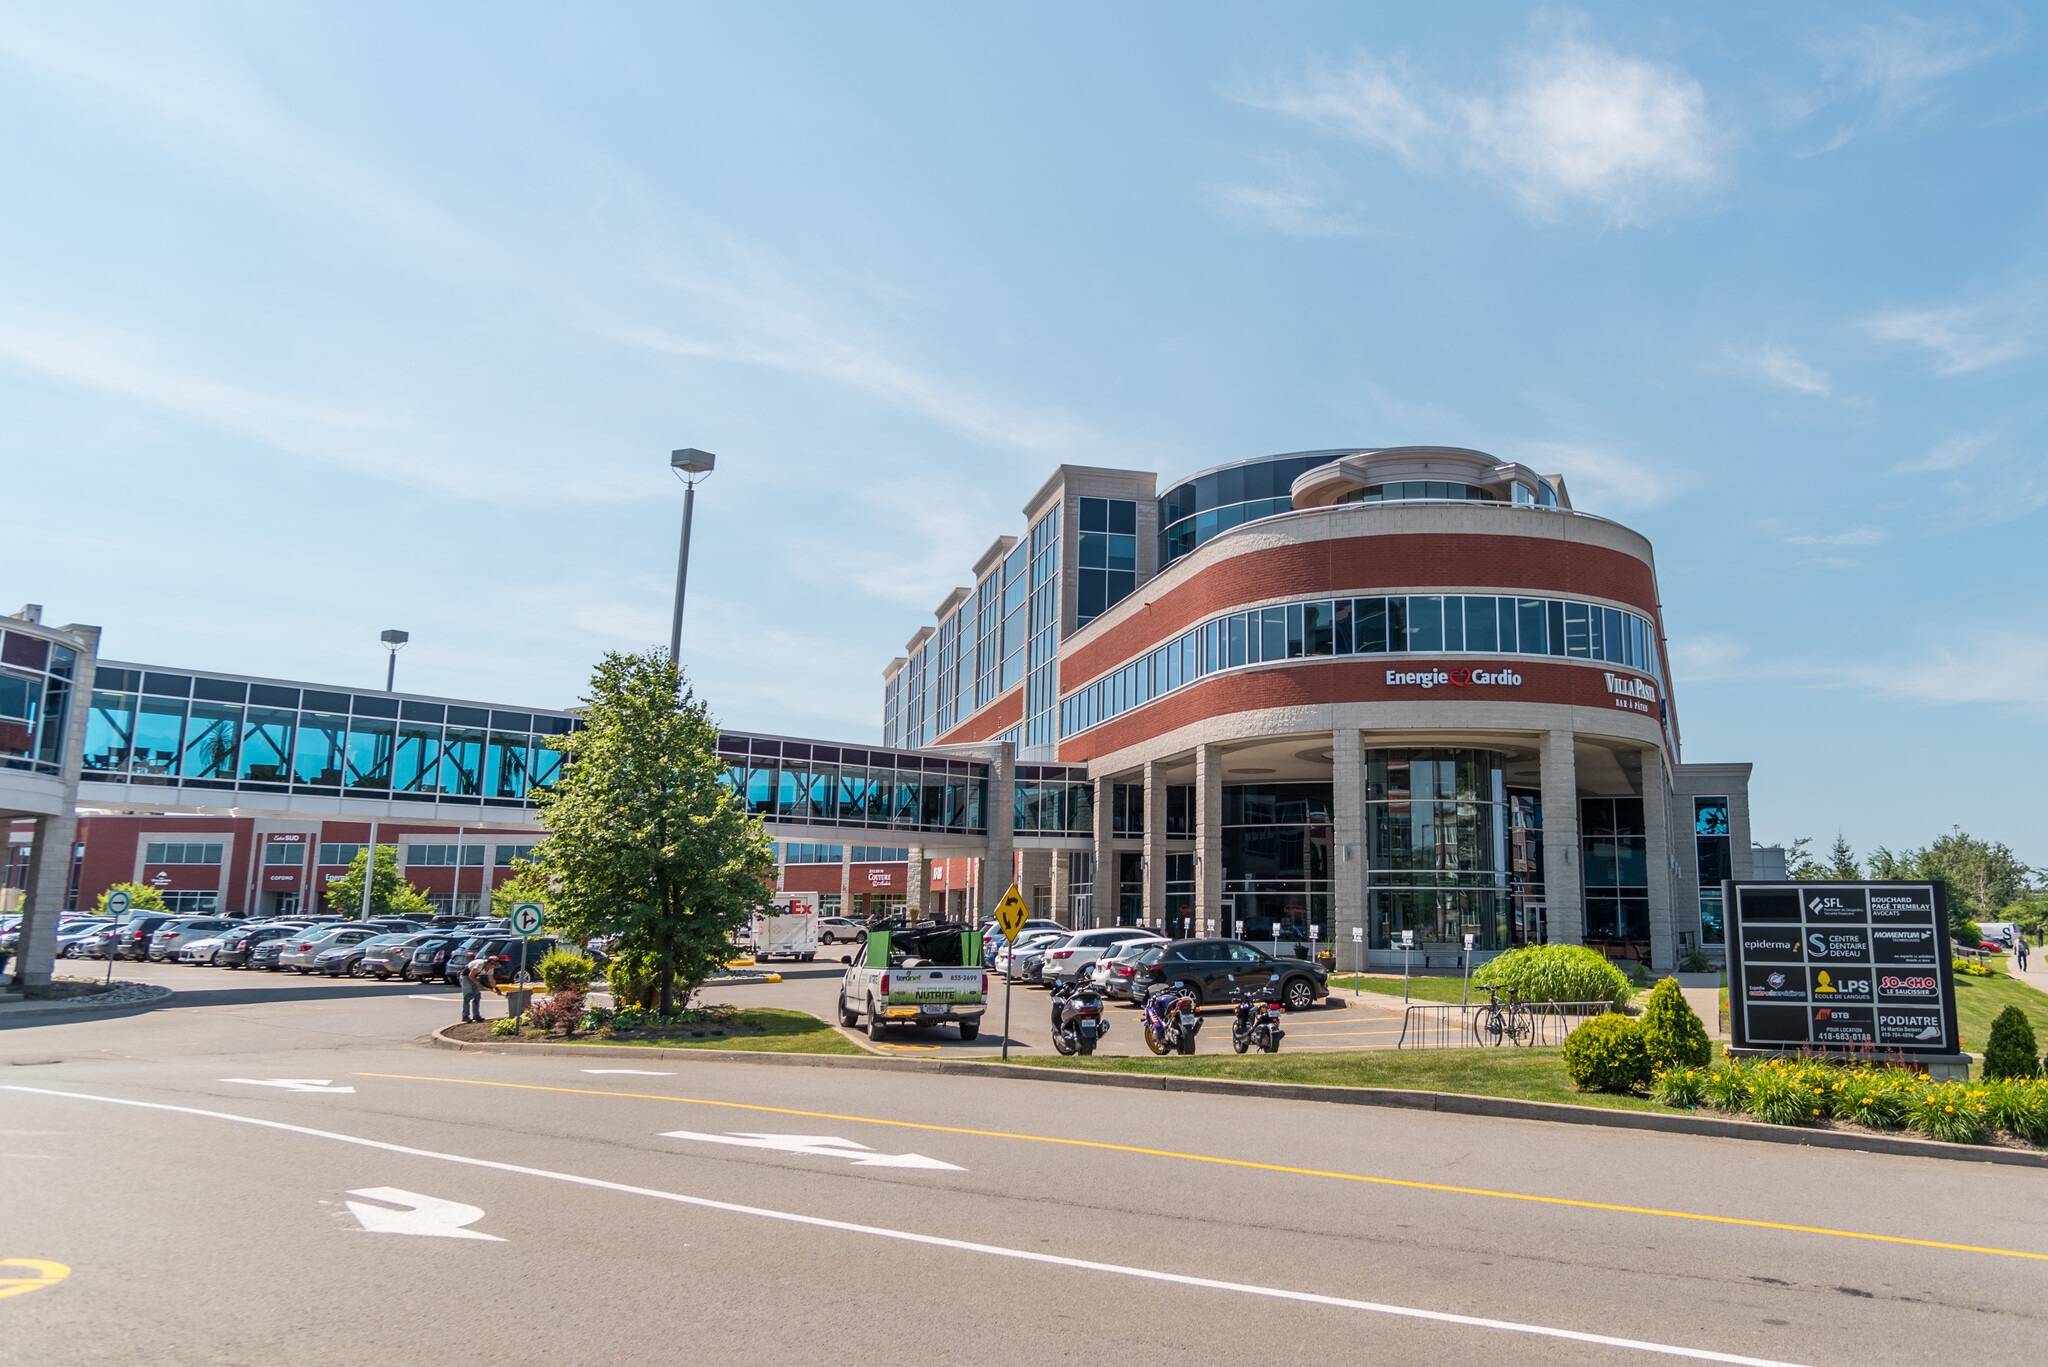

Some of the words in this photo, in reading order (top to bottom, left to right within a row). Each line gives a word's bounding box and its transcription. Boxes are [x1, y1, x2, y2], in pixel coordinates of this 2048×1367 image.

[1386, 668, 1448, 689] Energie
[1471, 668, 1522, 686] Cardio
[768, 899, 813, 915] edEx
[1823, 897, 1843, 908] SFL
[1744, 939, 1791, 950] epiderma
[1828, 935, 1859, 943] CENTRE
[1829, 942, 1867, 950] DENTAIRE
[1830, 949, 1861, 957] DEVEAU
[1838, 980, 1870, 993] LPS
[1881, 975, 1936, 989] SO-CHO
[915, 991, 955, 999] NUTRITE
[1880, 1015, 1939, 1026] PODIATRE
